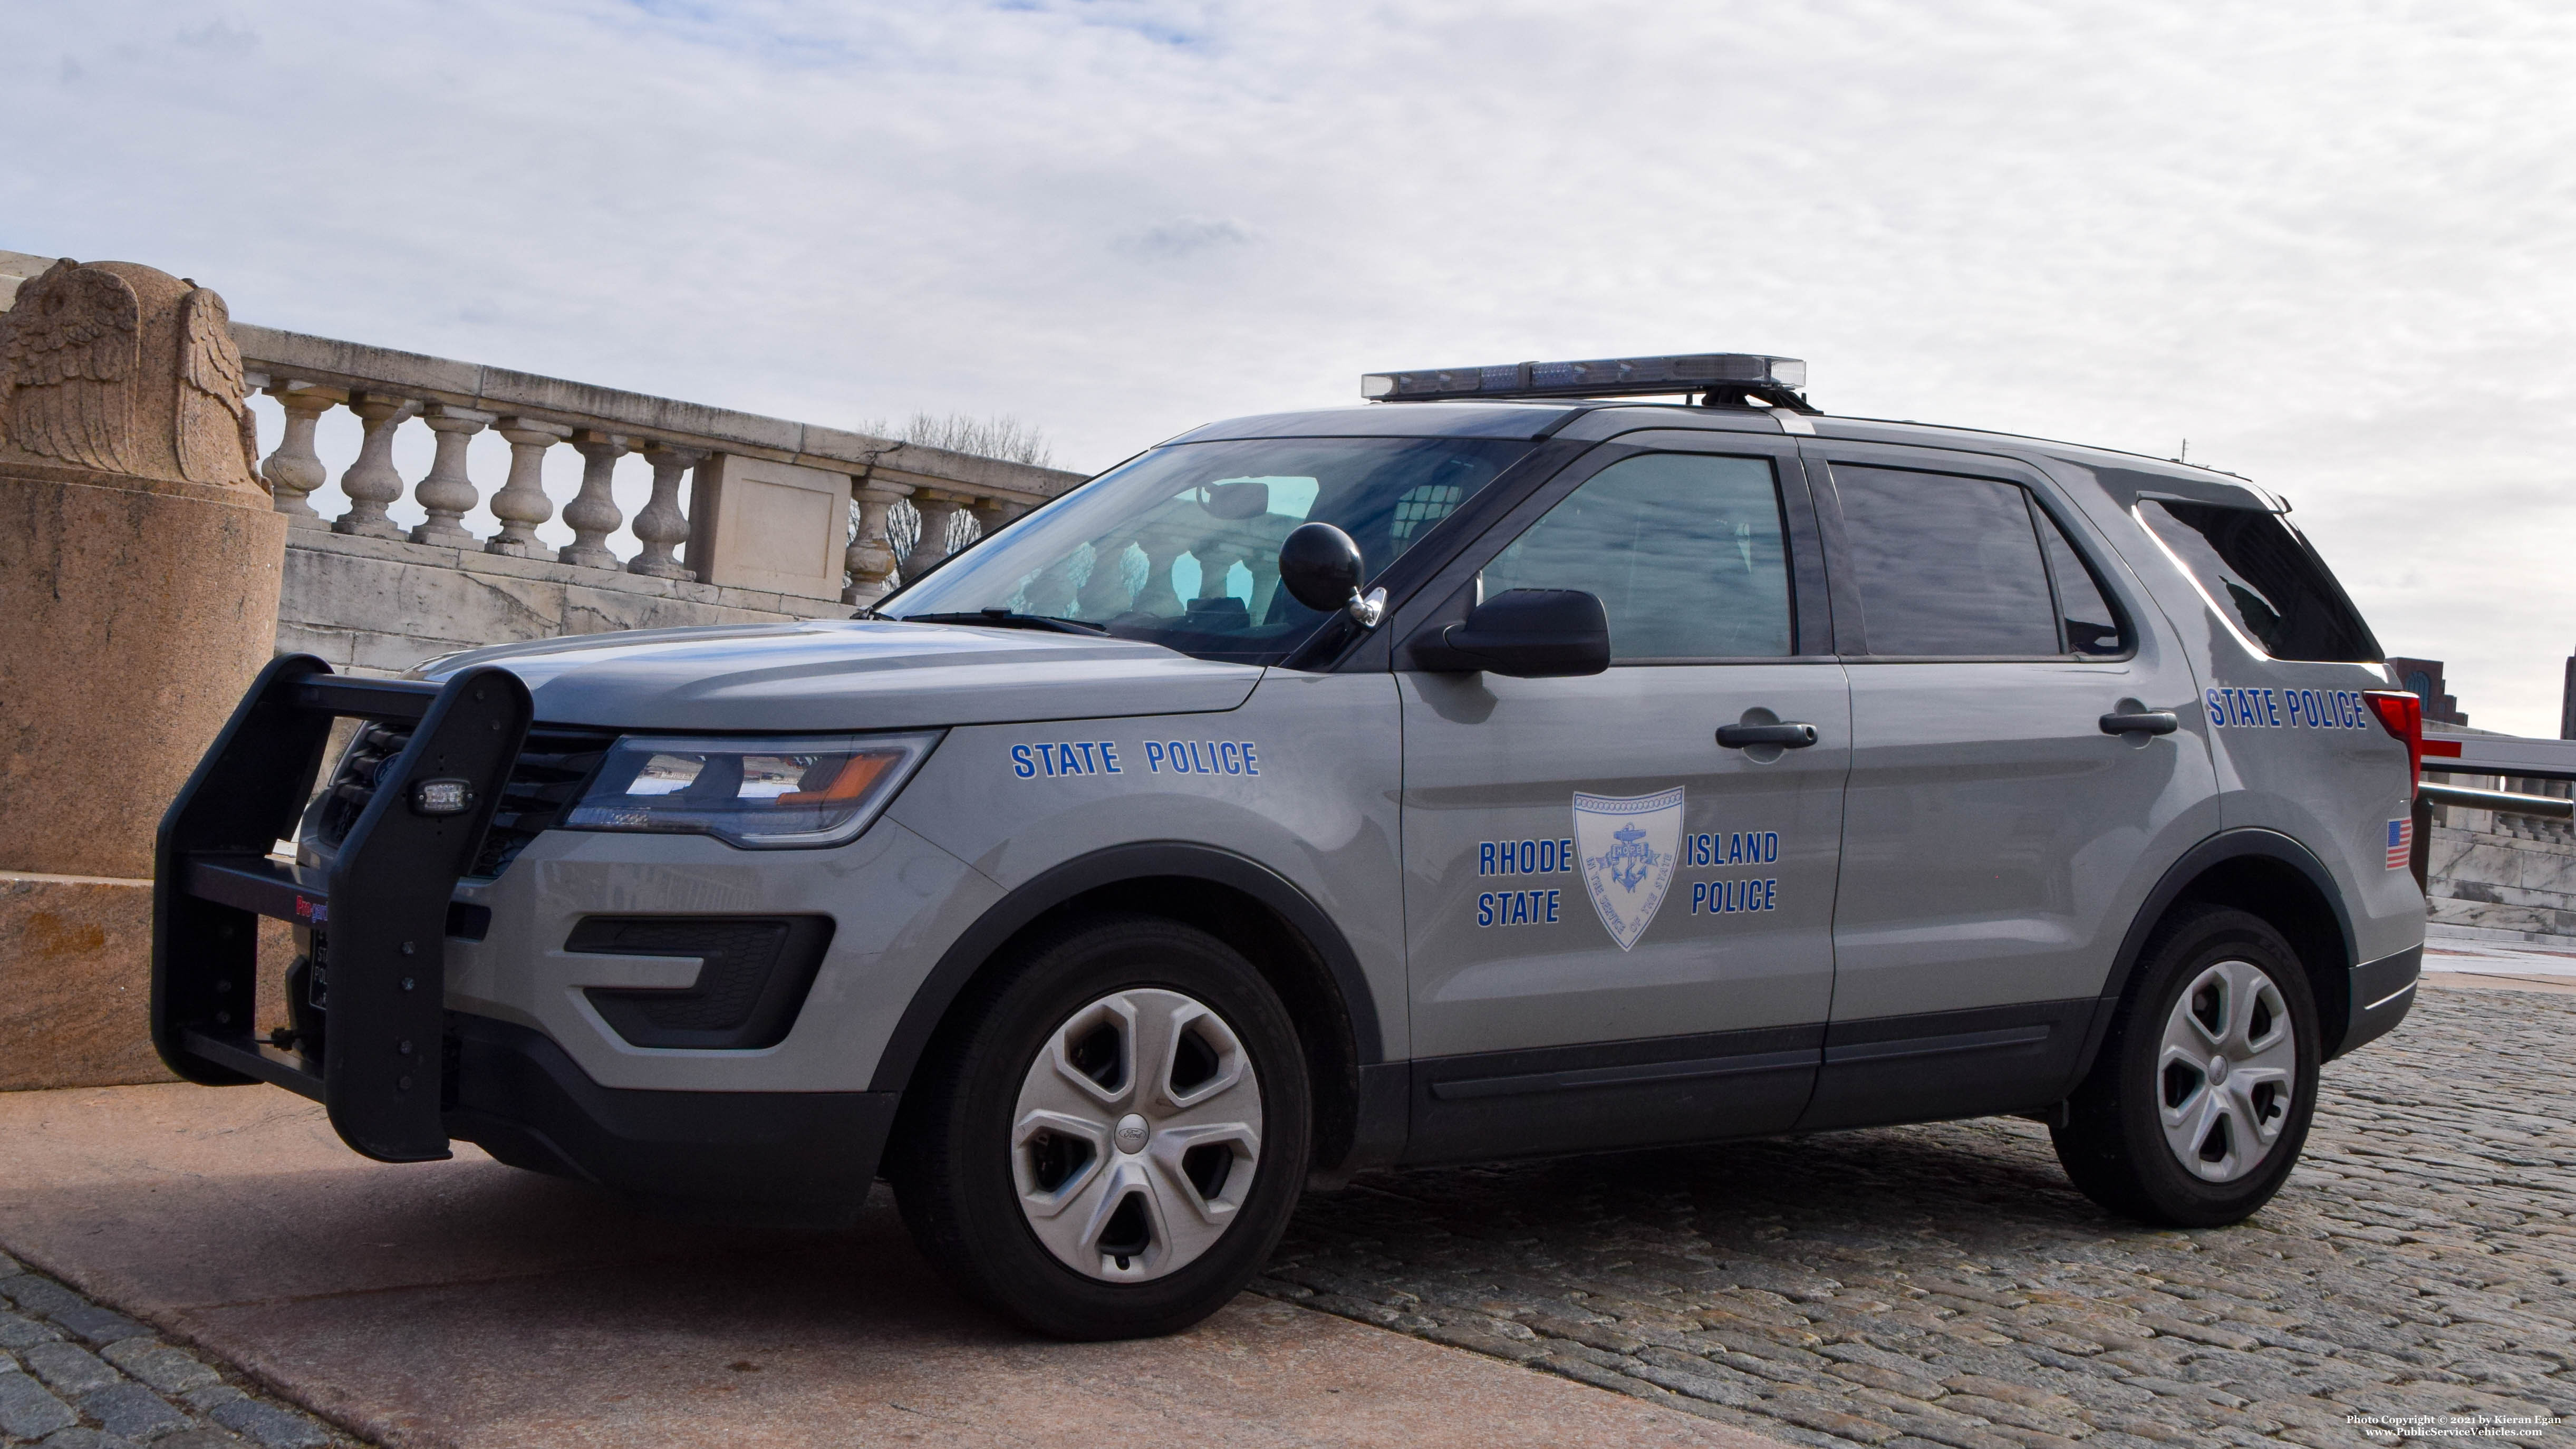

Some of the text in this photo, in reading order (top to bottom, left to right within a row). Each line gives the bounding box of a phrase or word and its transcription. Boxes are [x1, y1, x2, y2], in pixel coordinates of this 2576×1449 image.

[2205, 687, 2367, 730] STATE POLICE
[1010, 740, 1260, 780] STATE POLICE
[1478, 832, 1779, 876] RHODE ISLAND
[1617, 845, 1642, 855] HOPE
[1477, 878, 1778, 928] STATE POLICE
[1586, 853, 1672, 935] IN THE SERVICE OF THE STATE
[1124, 1129, 1143, 1138] Ford
